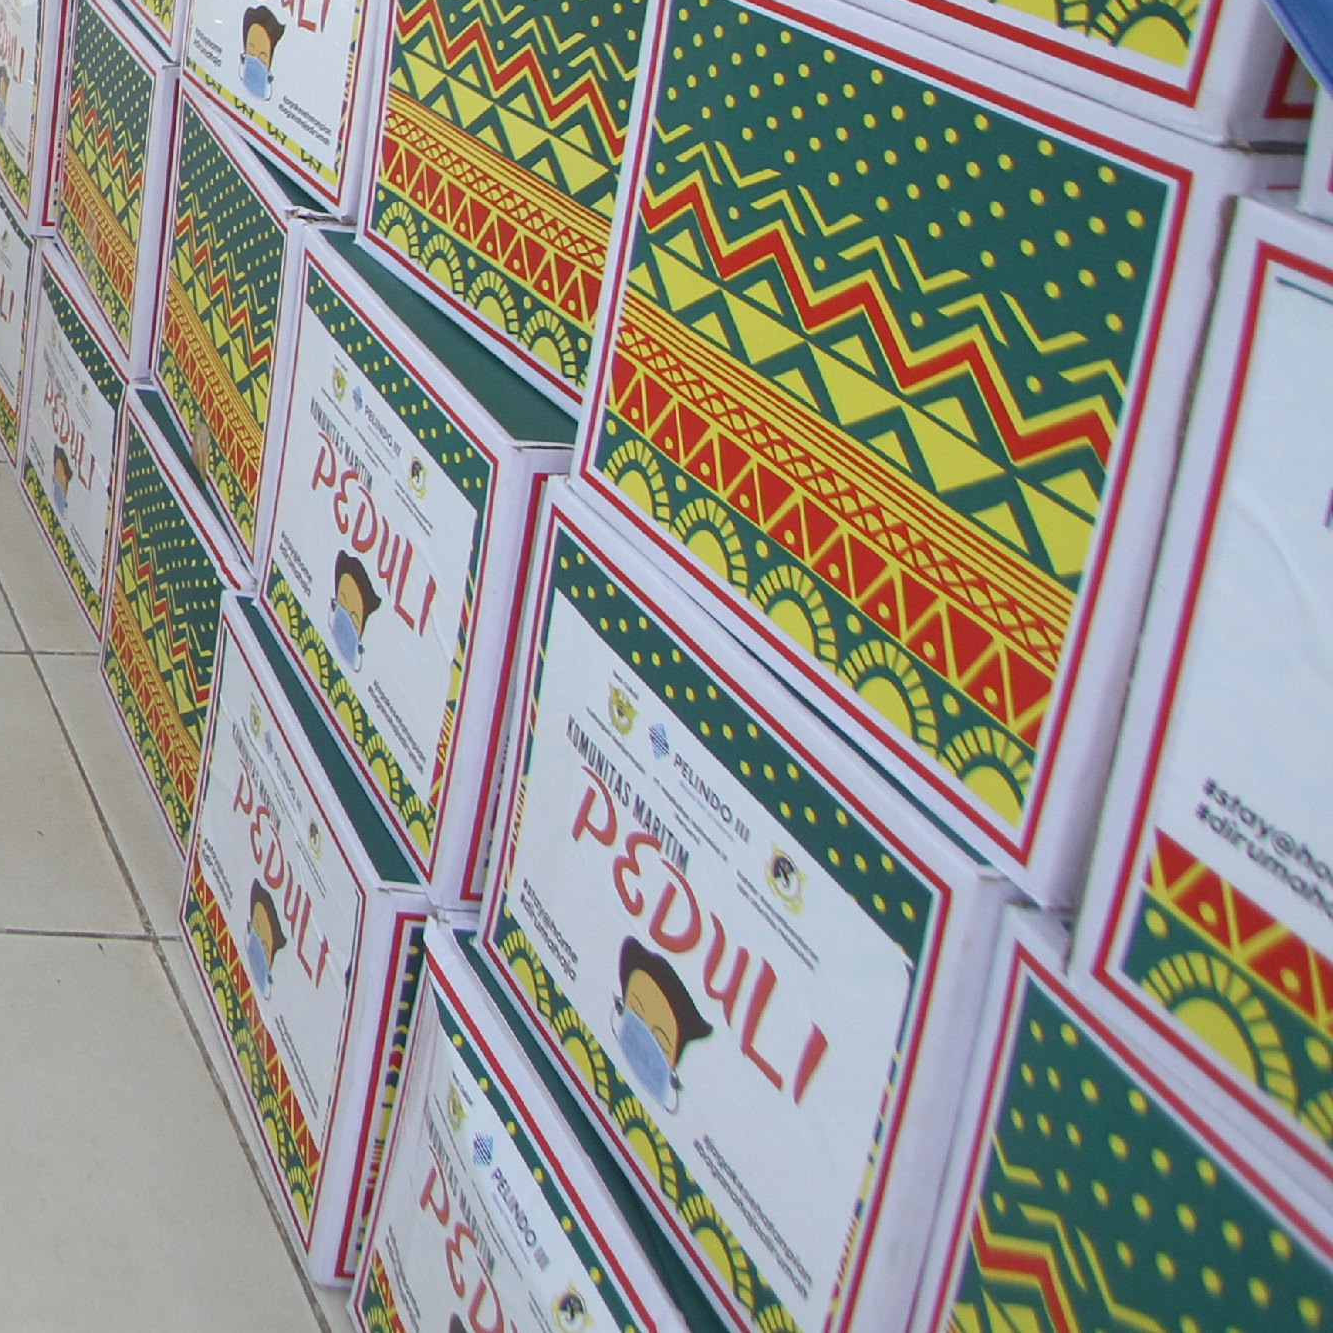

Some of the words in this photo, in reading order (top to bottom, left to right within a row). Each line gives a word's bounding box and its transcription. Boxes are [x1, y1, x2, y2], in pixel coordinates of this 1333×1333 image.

[43, 369, 97, 492] PEDULI
[310, 396, 344, 455] KOMUNITAS
[344, 442, 373, 493] MARITIM
[364, 404, 393, 447] PELINDO
[311, 431, 437, 637] PEDULI
[566, 714, 632, 808] KOMUNITAS
[632, 793, 690, 875] MARITIM
[673, 752, 733, 824] PELINDO
[733, 817, 751, 844] III
[233, 759, 329, 990] PEDULI
[522, 878, 578, 964] #stay@home
[520, 892, 577, 982] #dirumahaja
[572, 765, 829, 1106] PEDULI
[419, 1145, 519, 1333] PED
[491, 1166, 538, 1248] PELINDO
